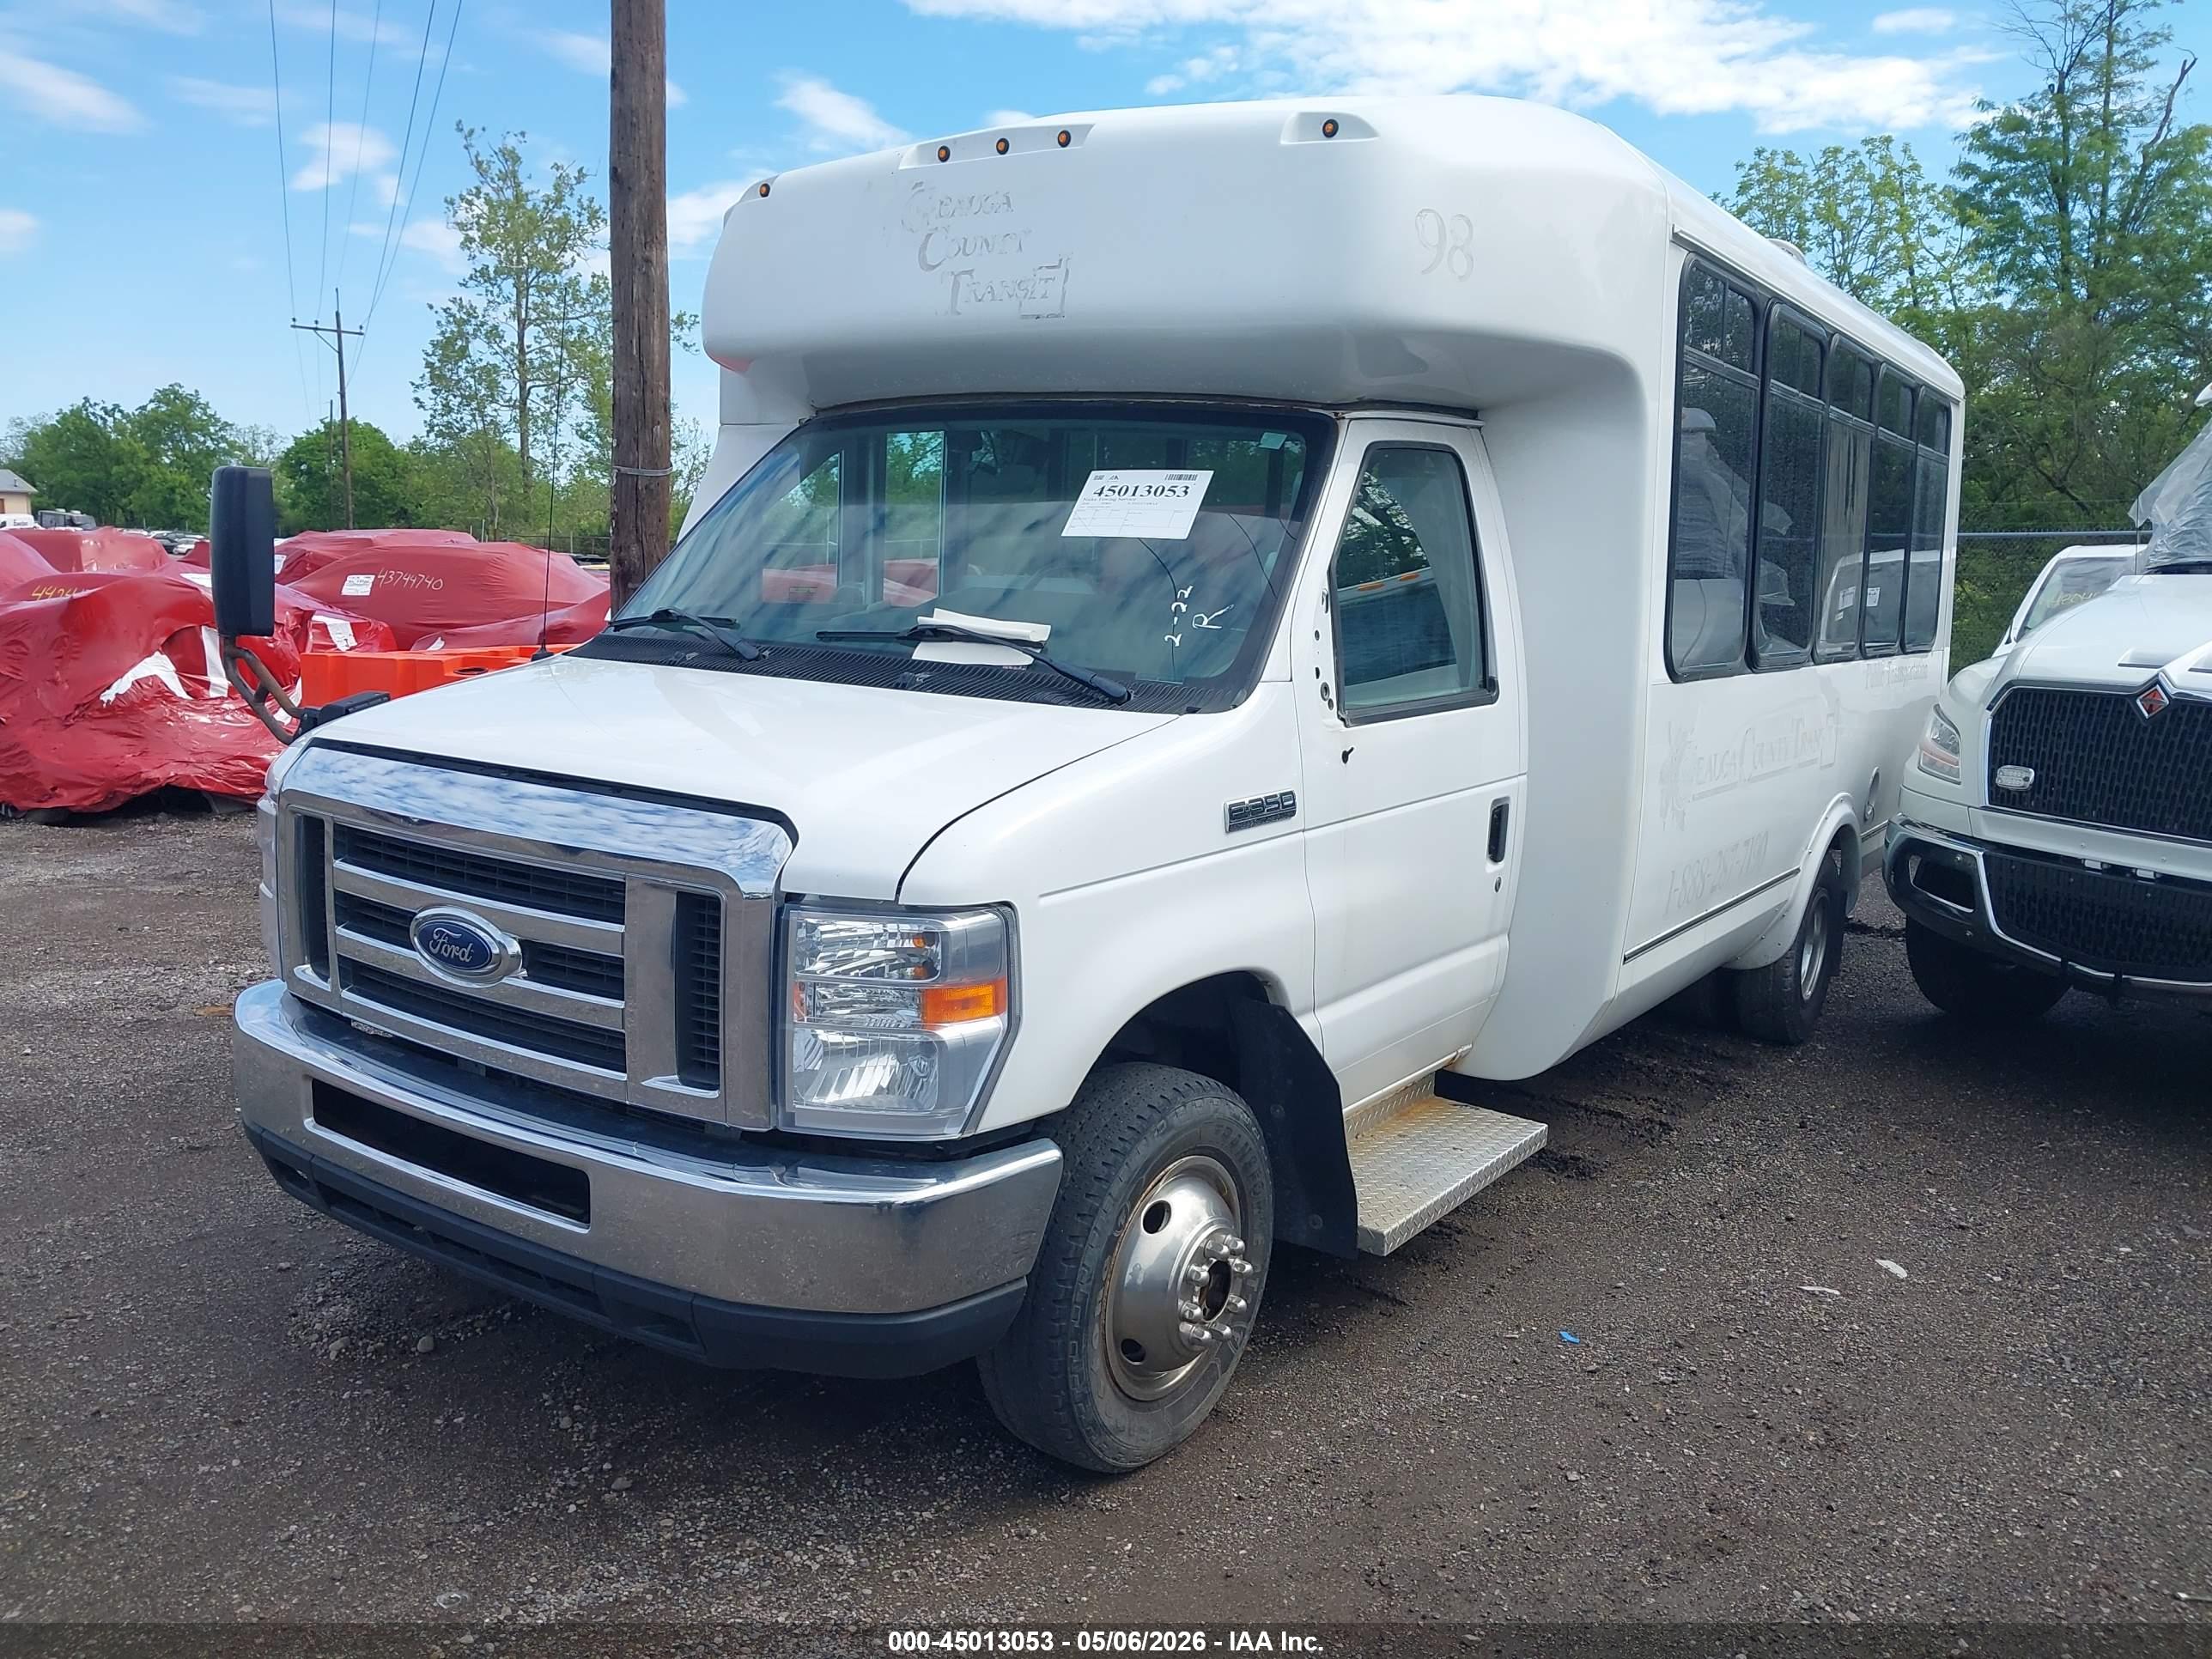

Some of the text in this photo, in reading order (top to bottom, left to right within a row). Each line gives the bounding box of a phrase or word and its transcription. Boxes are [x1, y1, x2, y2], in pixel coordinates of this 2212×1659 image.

[1414, 207, 1474, 283] 98
[1093, 484, 1190, 498] 45013053
[377, 567, 444, 591] 43744740
[1191, 604, 1235, 629] R
[429, 927, 474, 963] Ford
